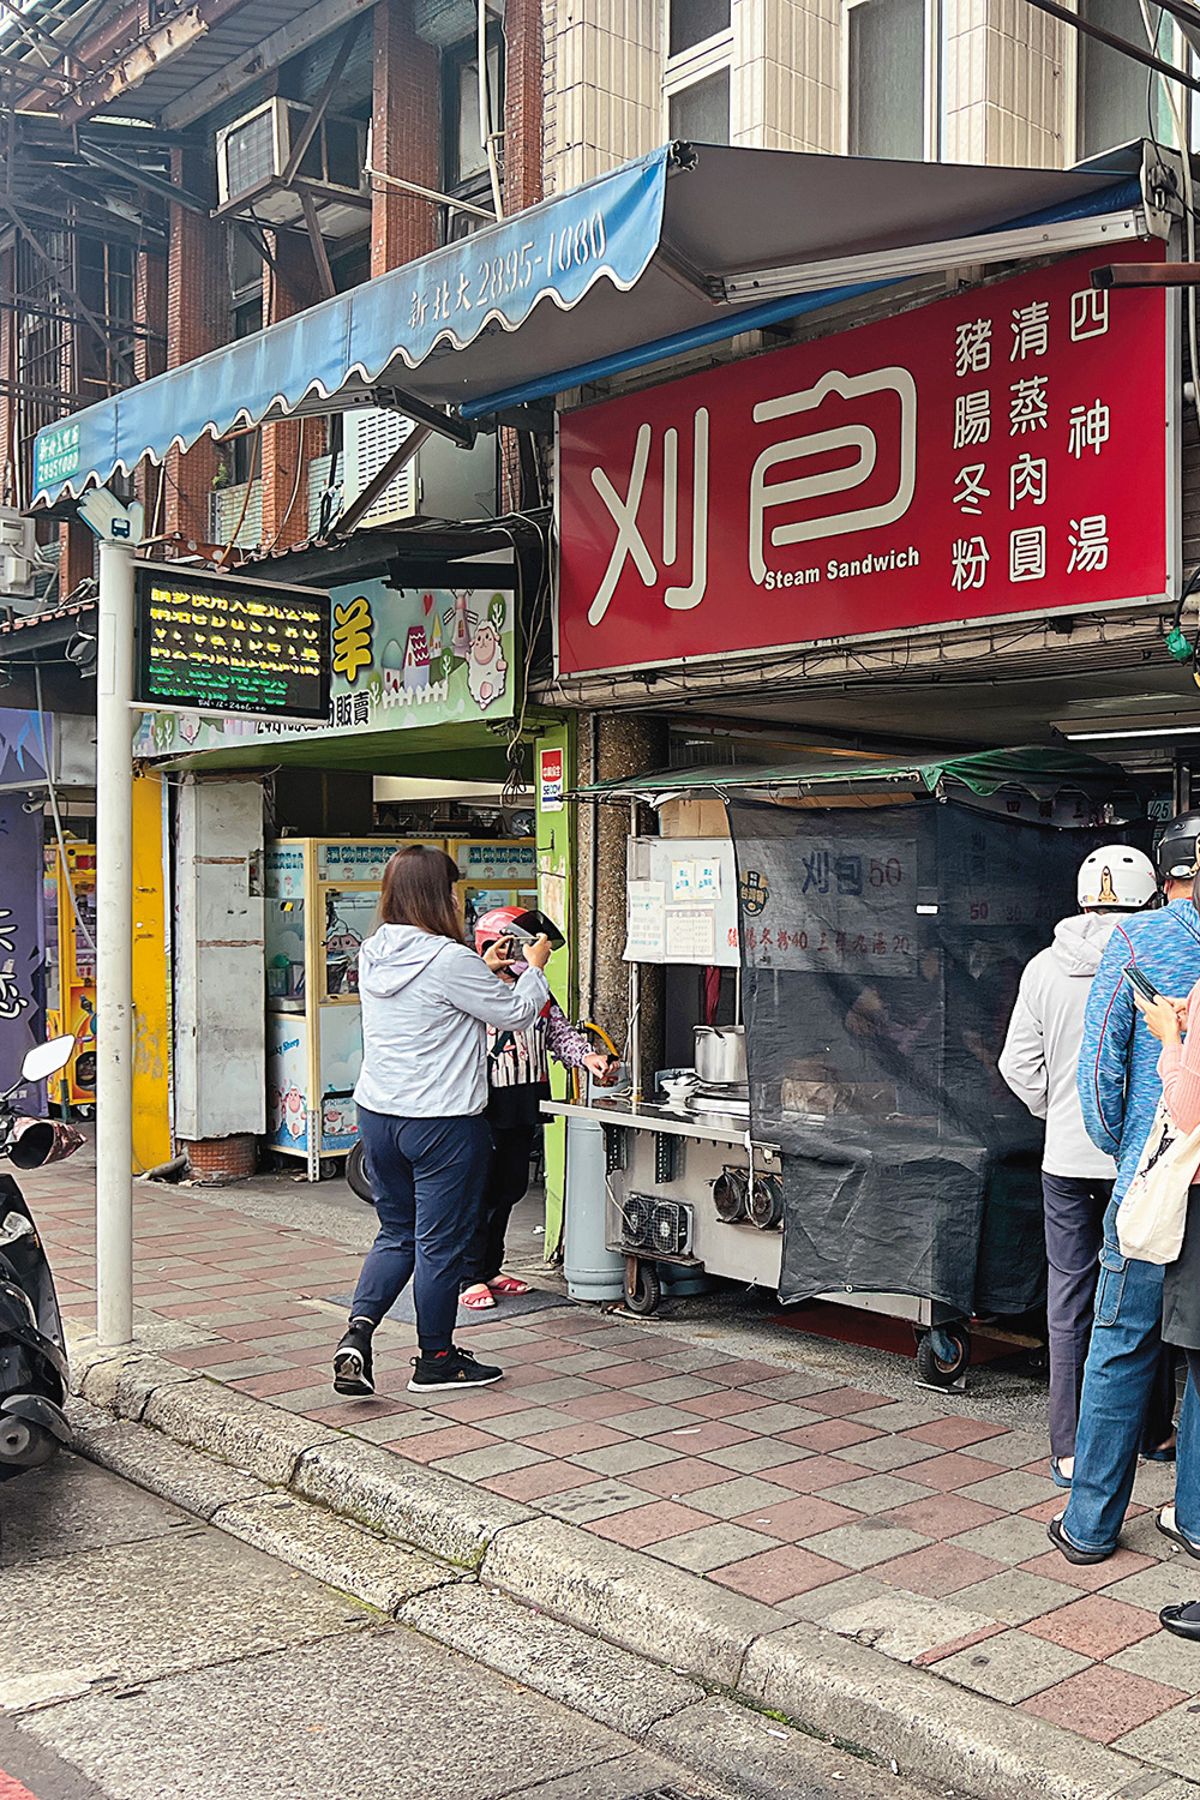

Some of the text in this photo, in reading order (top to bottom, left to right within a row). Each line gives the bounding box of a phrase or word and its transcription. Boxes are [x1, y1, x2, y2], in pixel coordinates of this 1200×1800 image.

[587, 366, 918, 627] 刈包
[951, 318, 992, 592] 豬腸冬粉
[1009, 301, 1050, 583] 清蒸肉圓
[1066, 287, 1110, 575] 四神湯
[333, 597, 372, 682] 羊
[764, 546, 920, 590] Steam Sandwich
